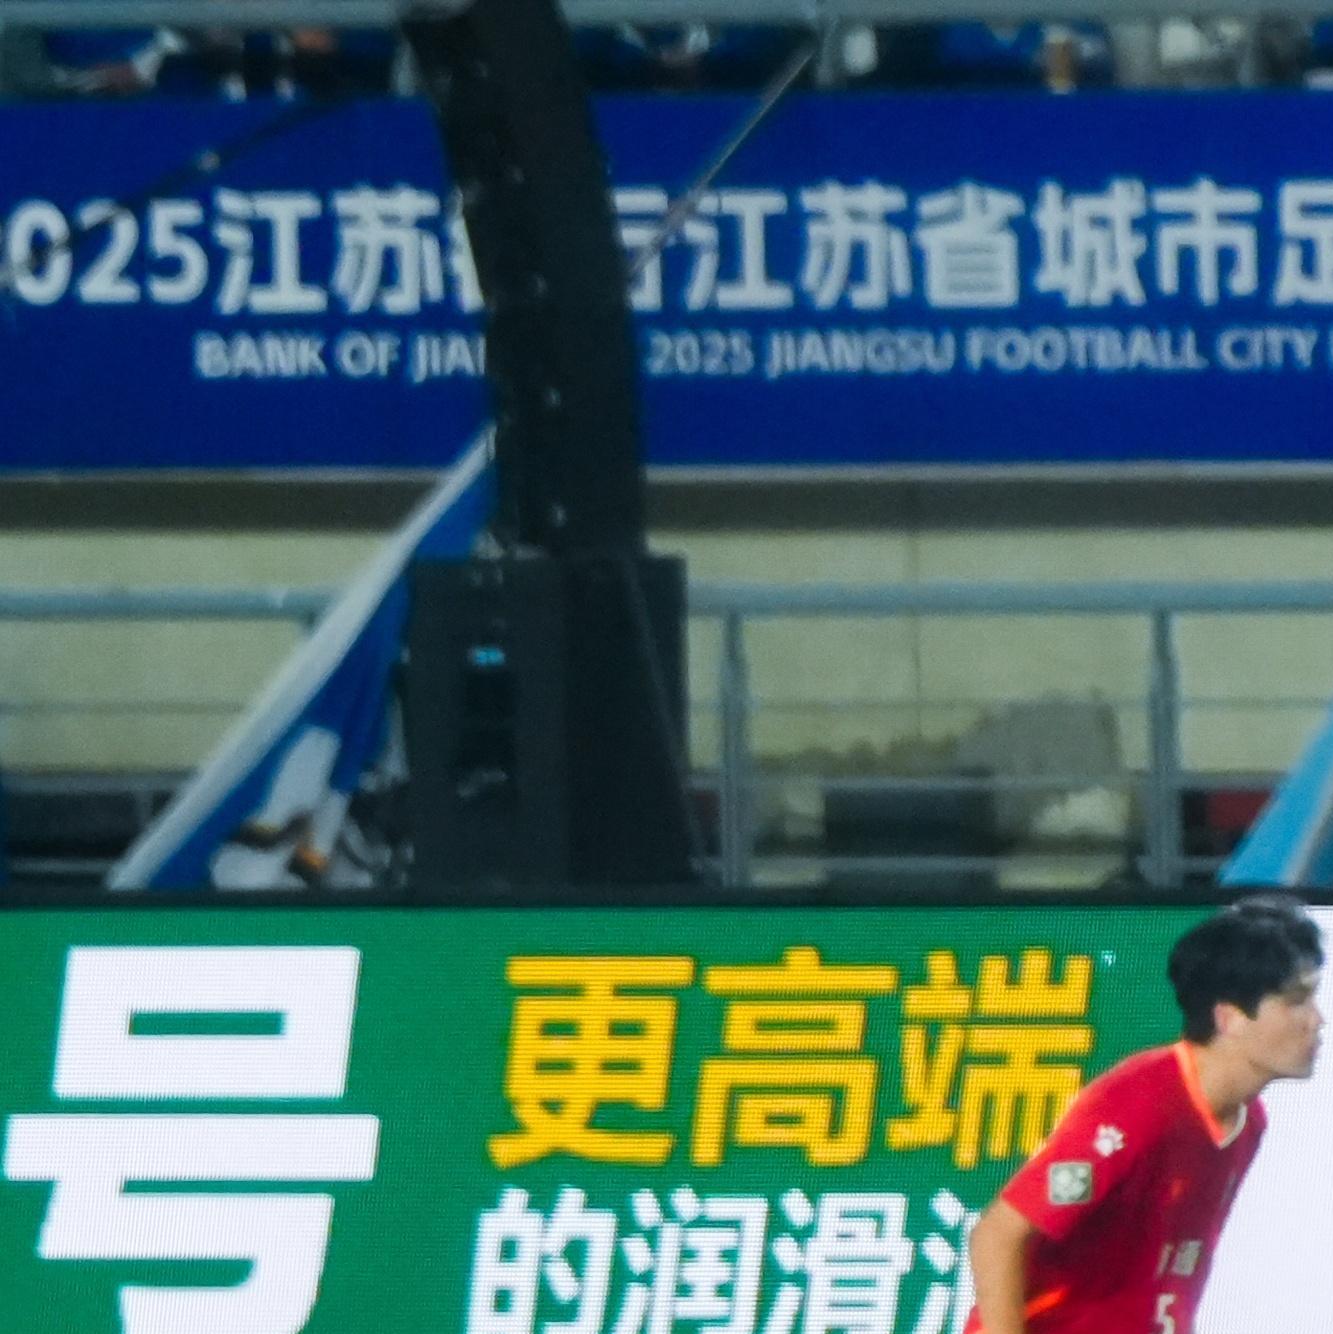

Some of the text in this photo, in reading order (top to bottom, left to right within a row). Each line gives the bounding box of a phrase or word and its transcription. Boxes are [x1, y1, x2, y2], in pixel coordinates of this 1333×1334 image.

[195, 332, 327, 378] BANK
[336, 332, 400, 378] OF
[411, 332, 487, 383] JIA
[646, 330, 755, 376] 2025
[765, 328, 956, 380] JIANGSU
[966, 325, 1208, 373] FOOTBALL
[1218, 323, 1318, 370] CITY
[488, 944, 1096, 1170] 更高端
